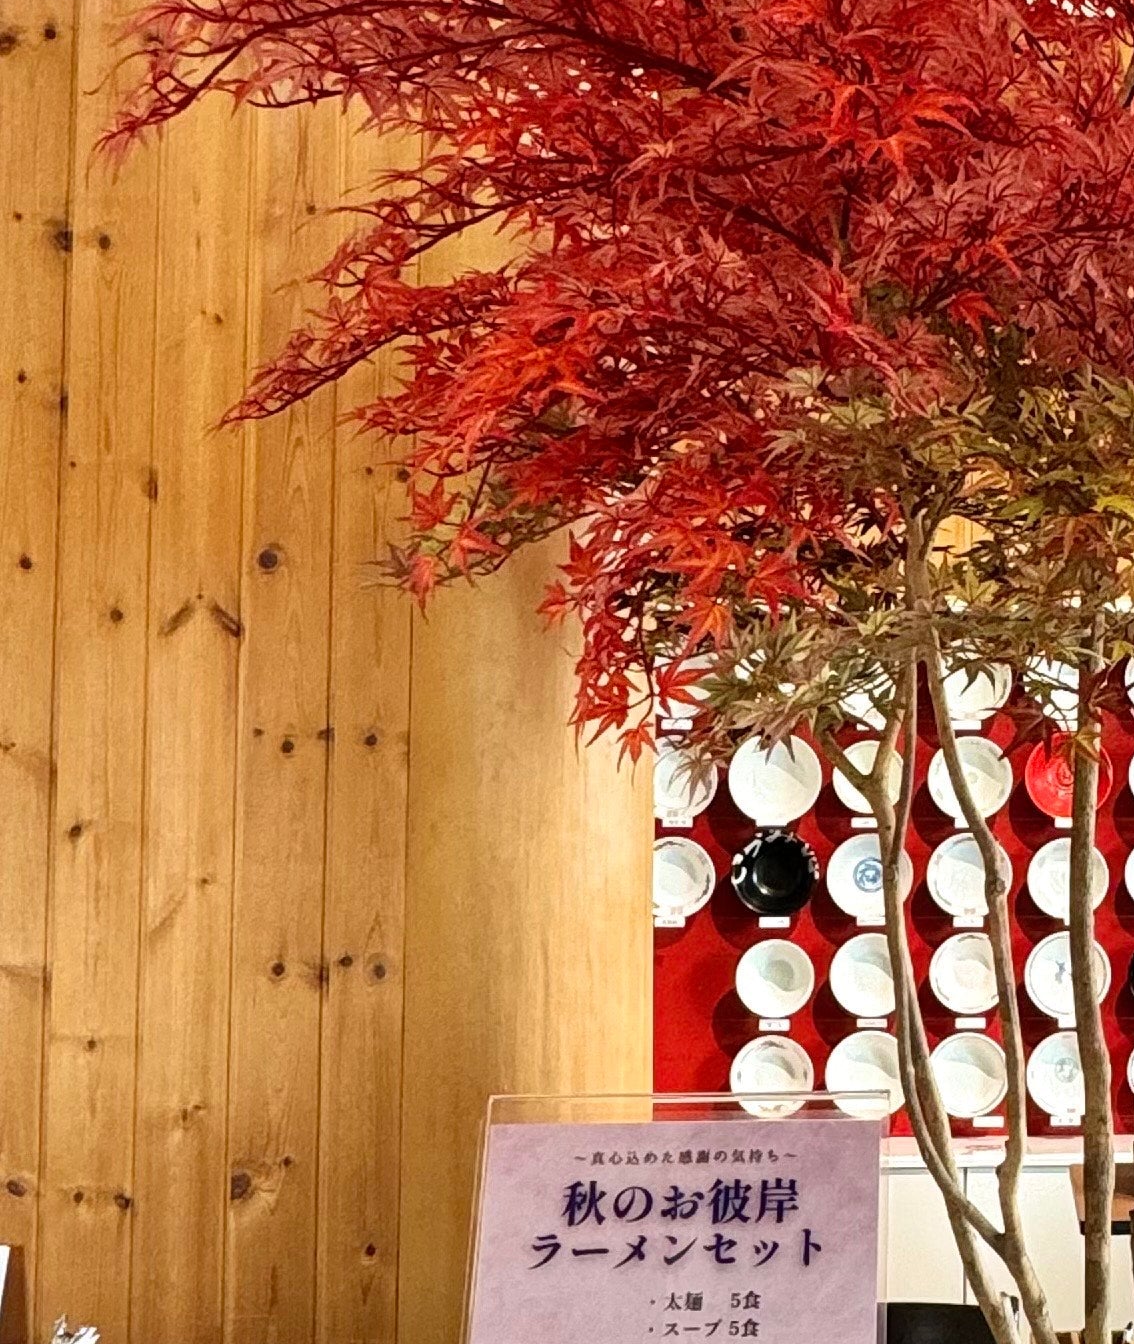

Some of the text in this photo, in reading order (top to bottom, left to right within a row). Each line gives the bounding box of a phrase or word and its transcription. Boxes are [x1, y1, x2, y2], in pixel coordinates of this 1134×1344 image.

[561, 1177, 800, 1226] 秋のお彼岸
[528, 1229, 823, 1270] ラーメンセット
